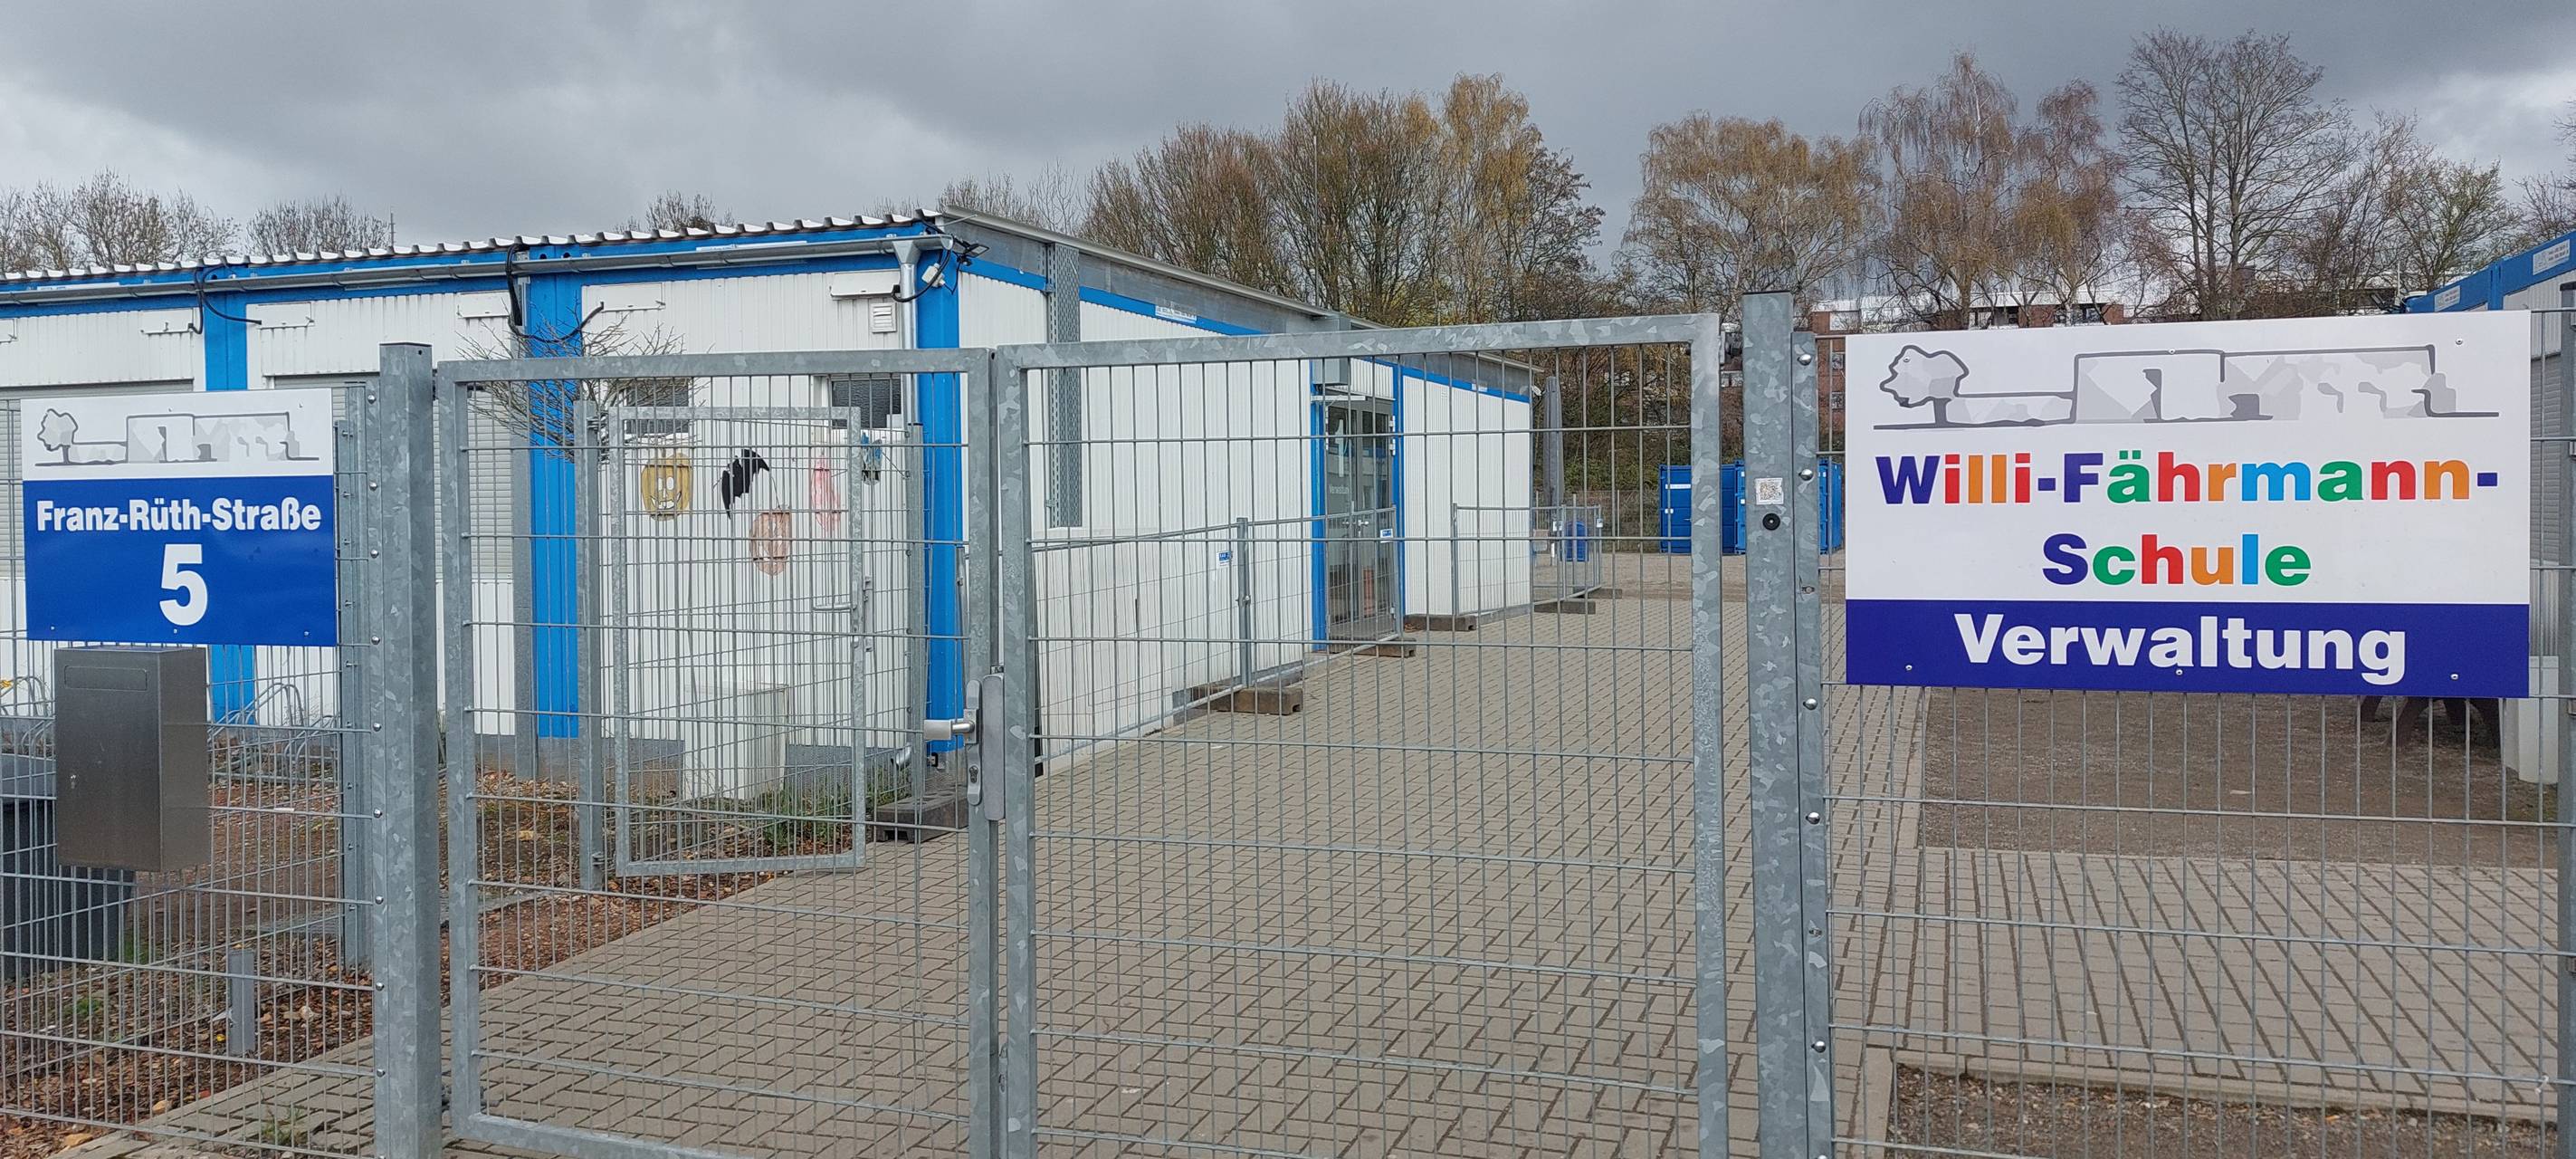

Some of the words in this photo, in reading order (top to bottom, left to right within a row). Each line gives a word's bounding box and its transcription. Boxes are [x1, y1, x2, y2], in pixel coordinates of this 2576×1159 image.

[1876, 450, 2498, 504] Willi-Fährmann-
[38, 497, 321, 532] Franz-Rüth-Straße
[160, 544, 208, 626] 5
[2043, 533, 2312, 587] Schule
[1954, 614, 2406, 685] Verwaltung
